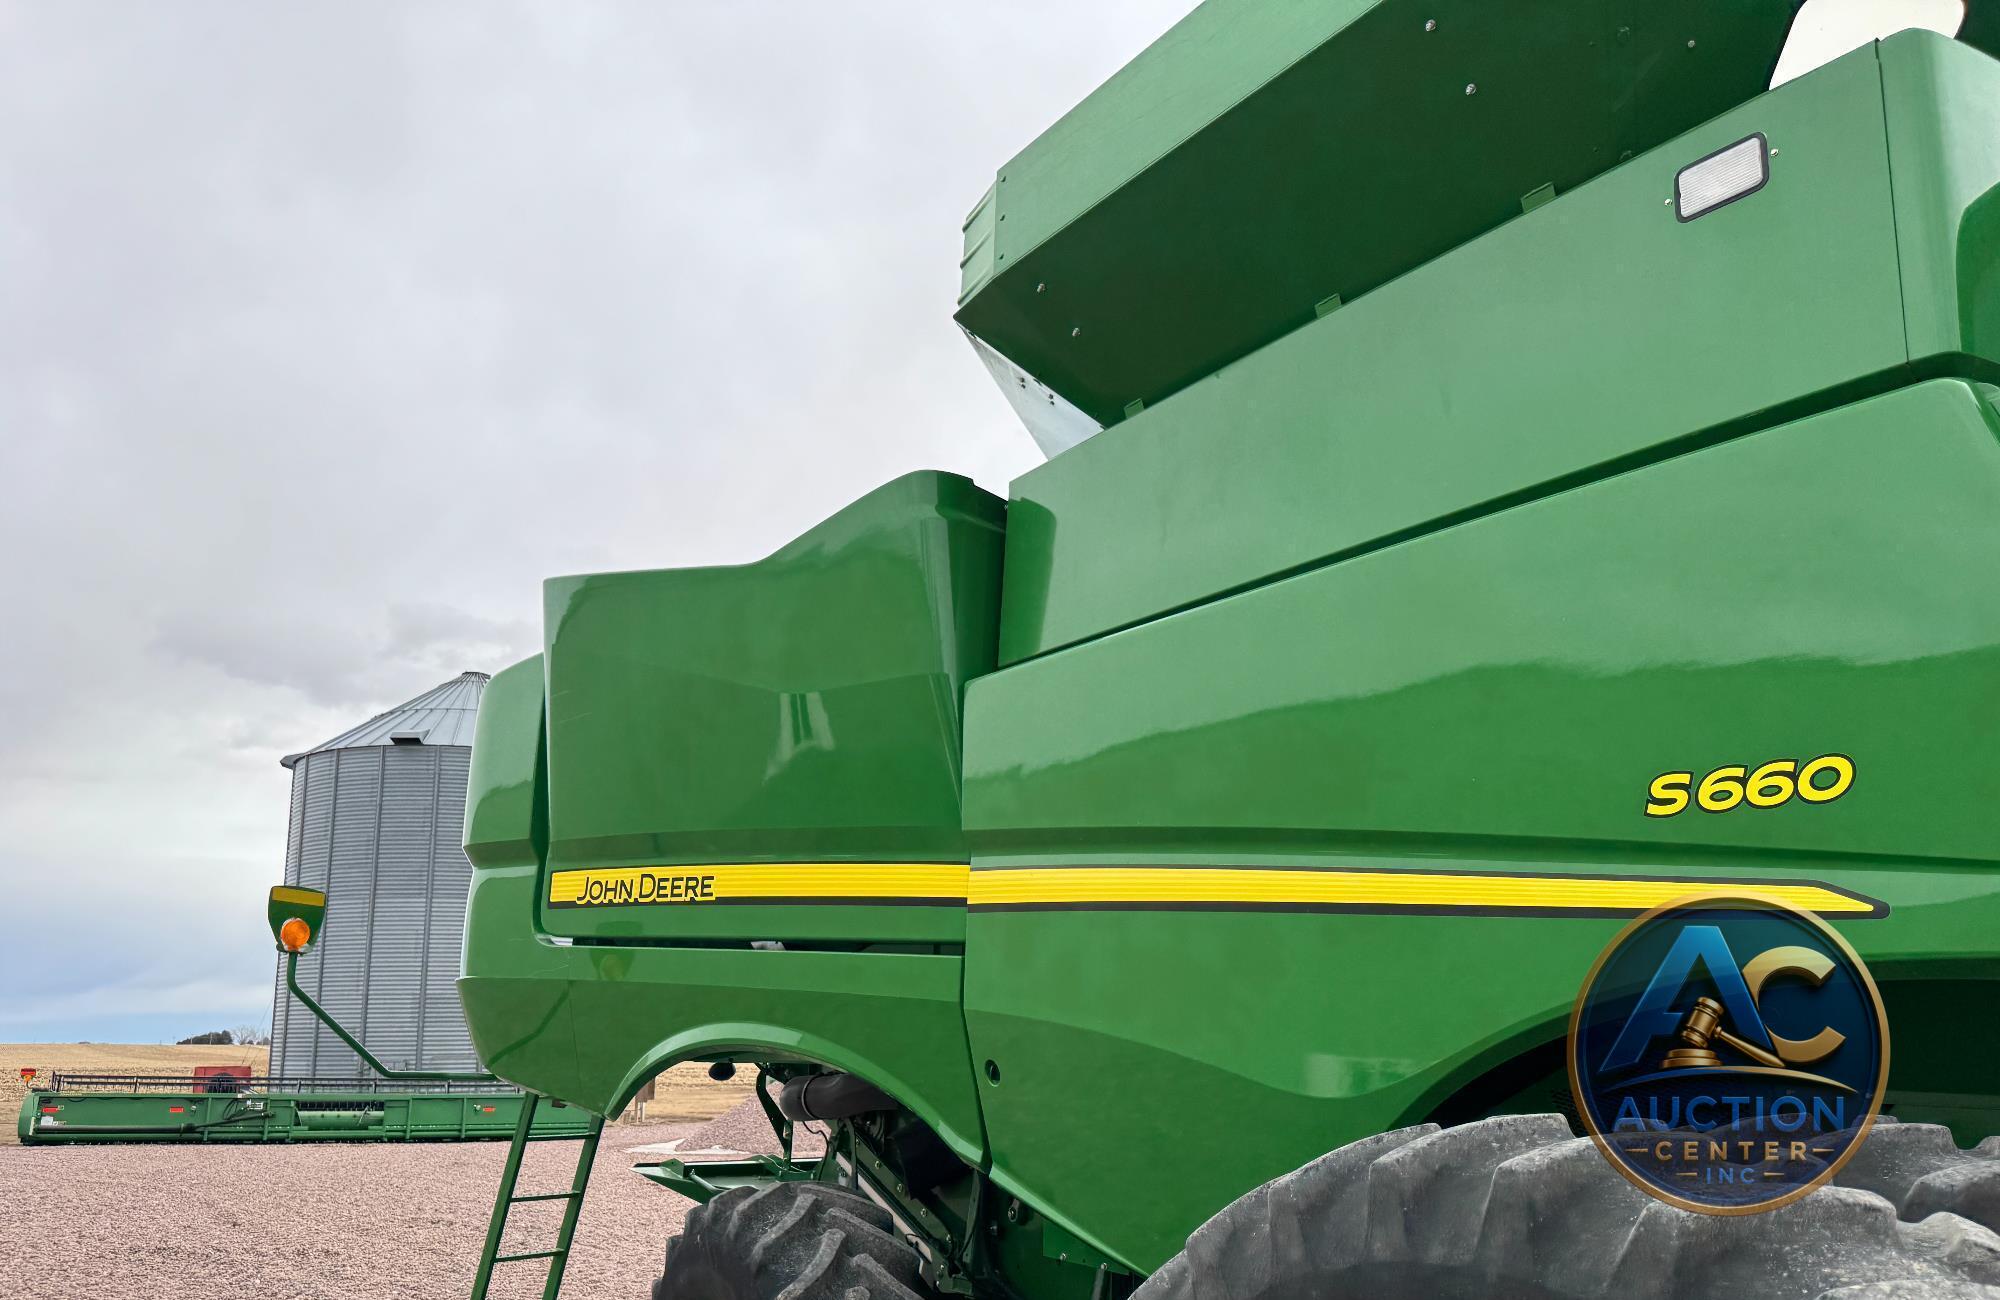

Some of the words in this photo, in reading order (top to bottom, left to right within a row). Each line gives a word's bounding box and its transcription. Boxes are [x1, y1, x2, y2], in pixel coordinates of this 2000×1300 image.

[1644, 753, 1857, 818] S660
[577, 876, 634, 901] JOHN
[639, 873, 715, 899] DEERE
